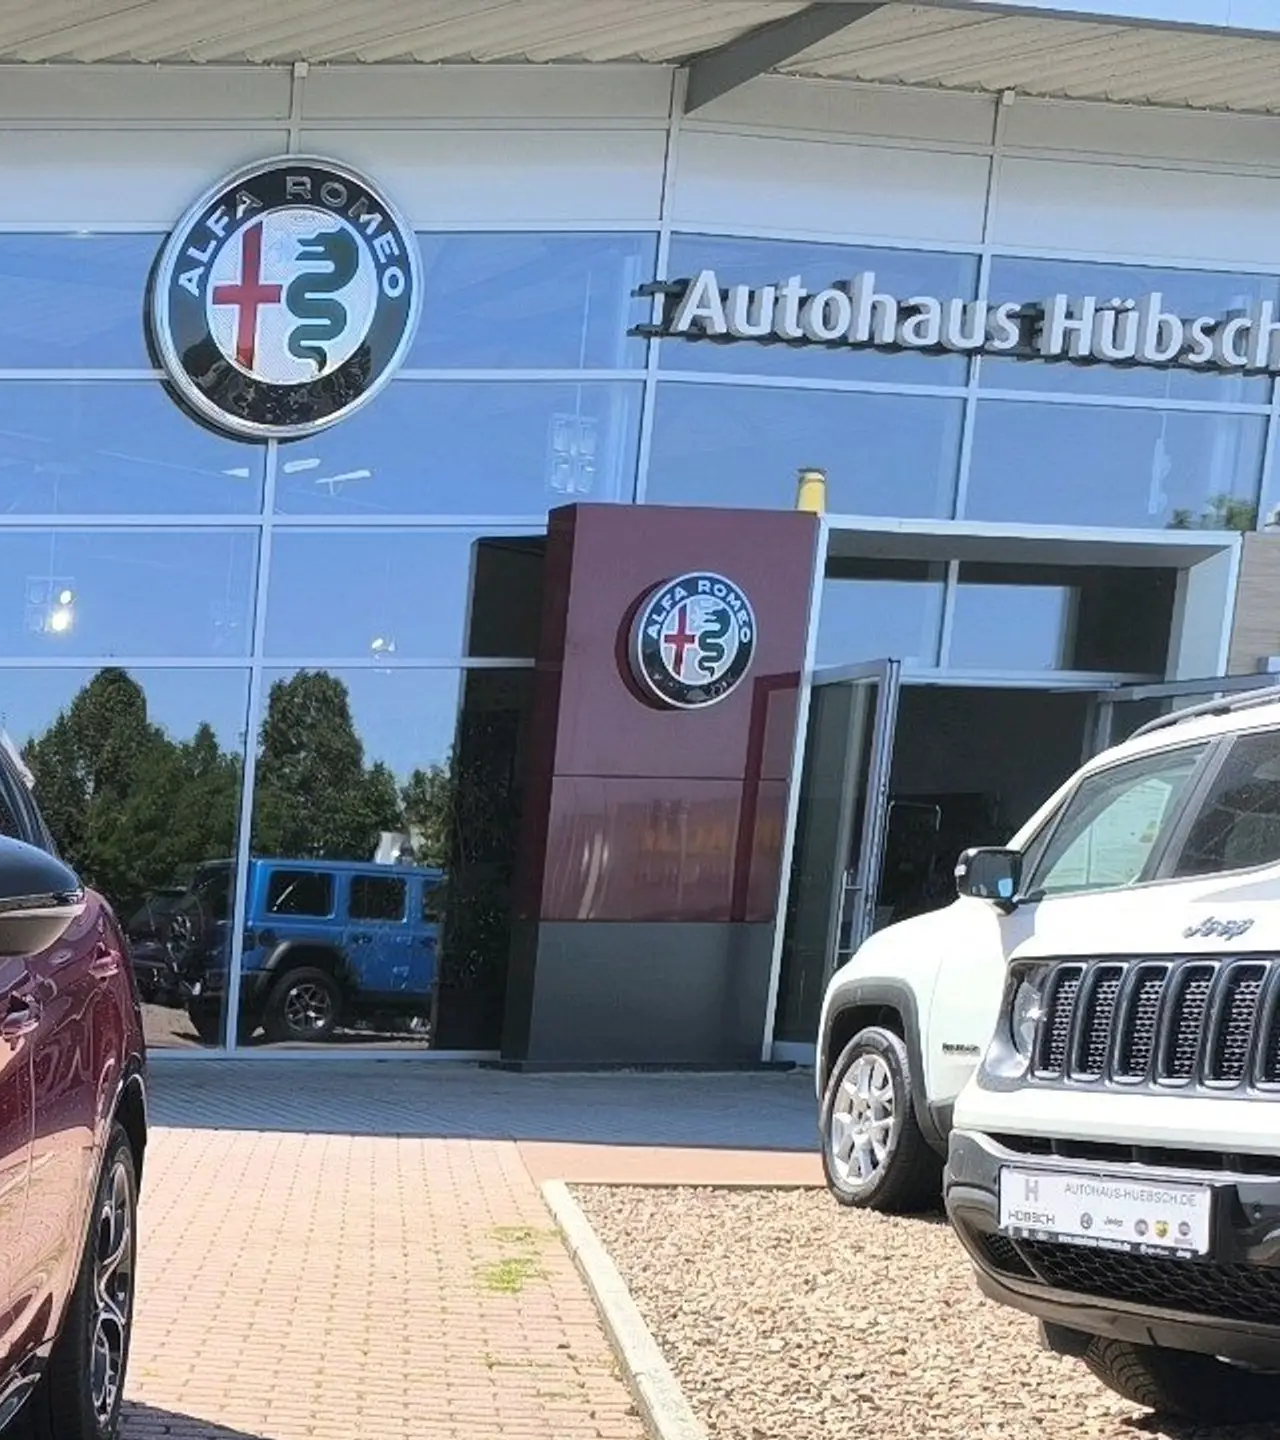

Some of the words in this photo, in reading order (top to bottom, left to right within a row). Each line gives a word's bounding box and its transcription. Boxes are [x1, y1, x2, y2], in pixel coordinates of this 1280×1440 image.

[179, 189, 264, 299] ALFA
[285, 175, 406, 300] ROMEO
[676, 269, 1021, 351] Autohaus
[1042, 291, 1280, 368] Hübsch
[647, 585, 688, 640] ALFA
[698, 579, 752, 643] ROMEO
